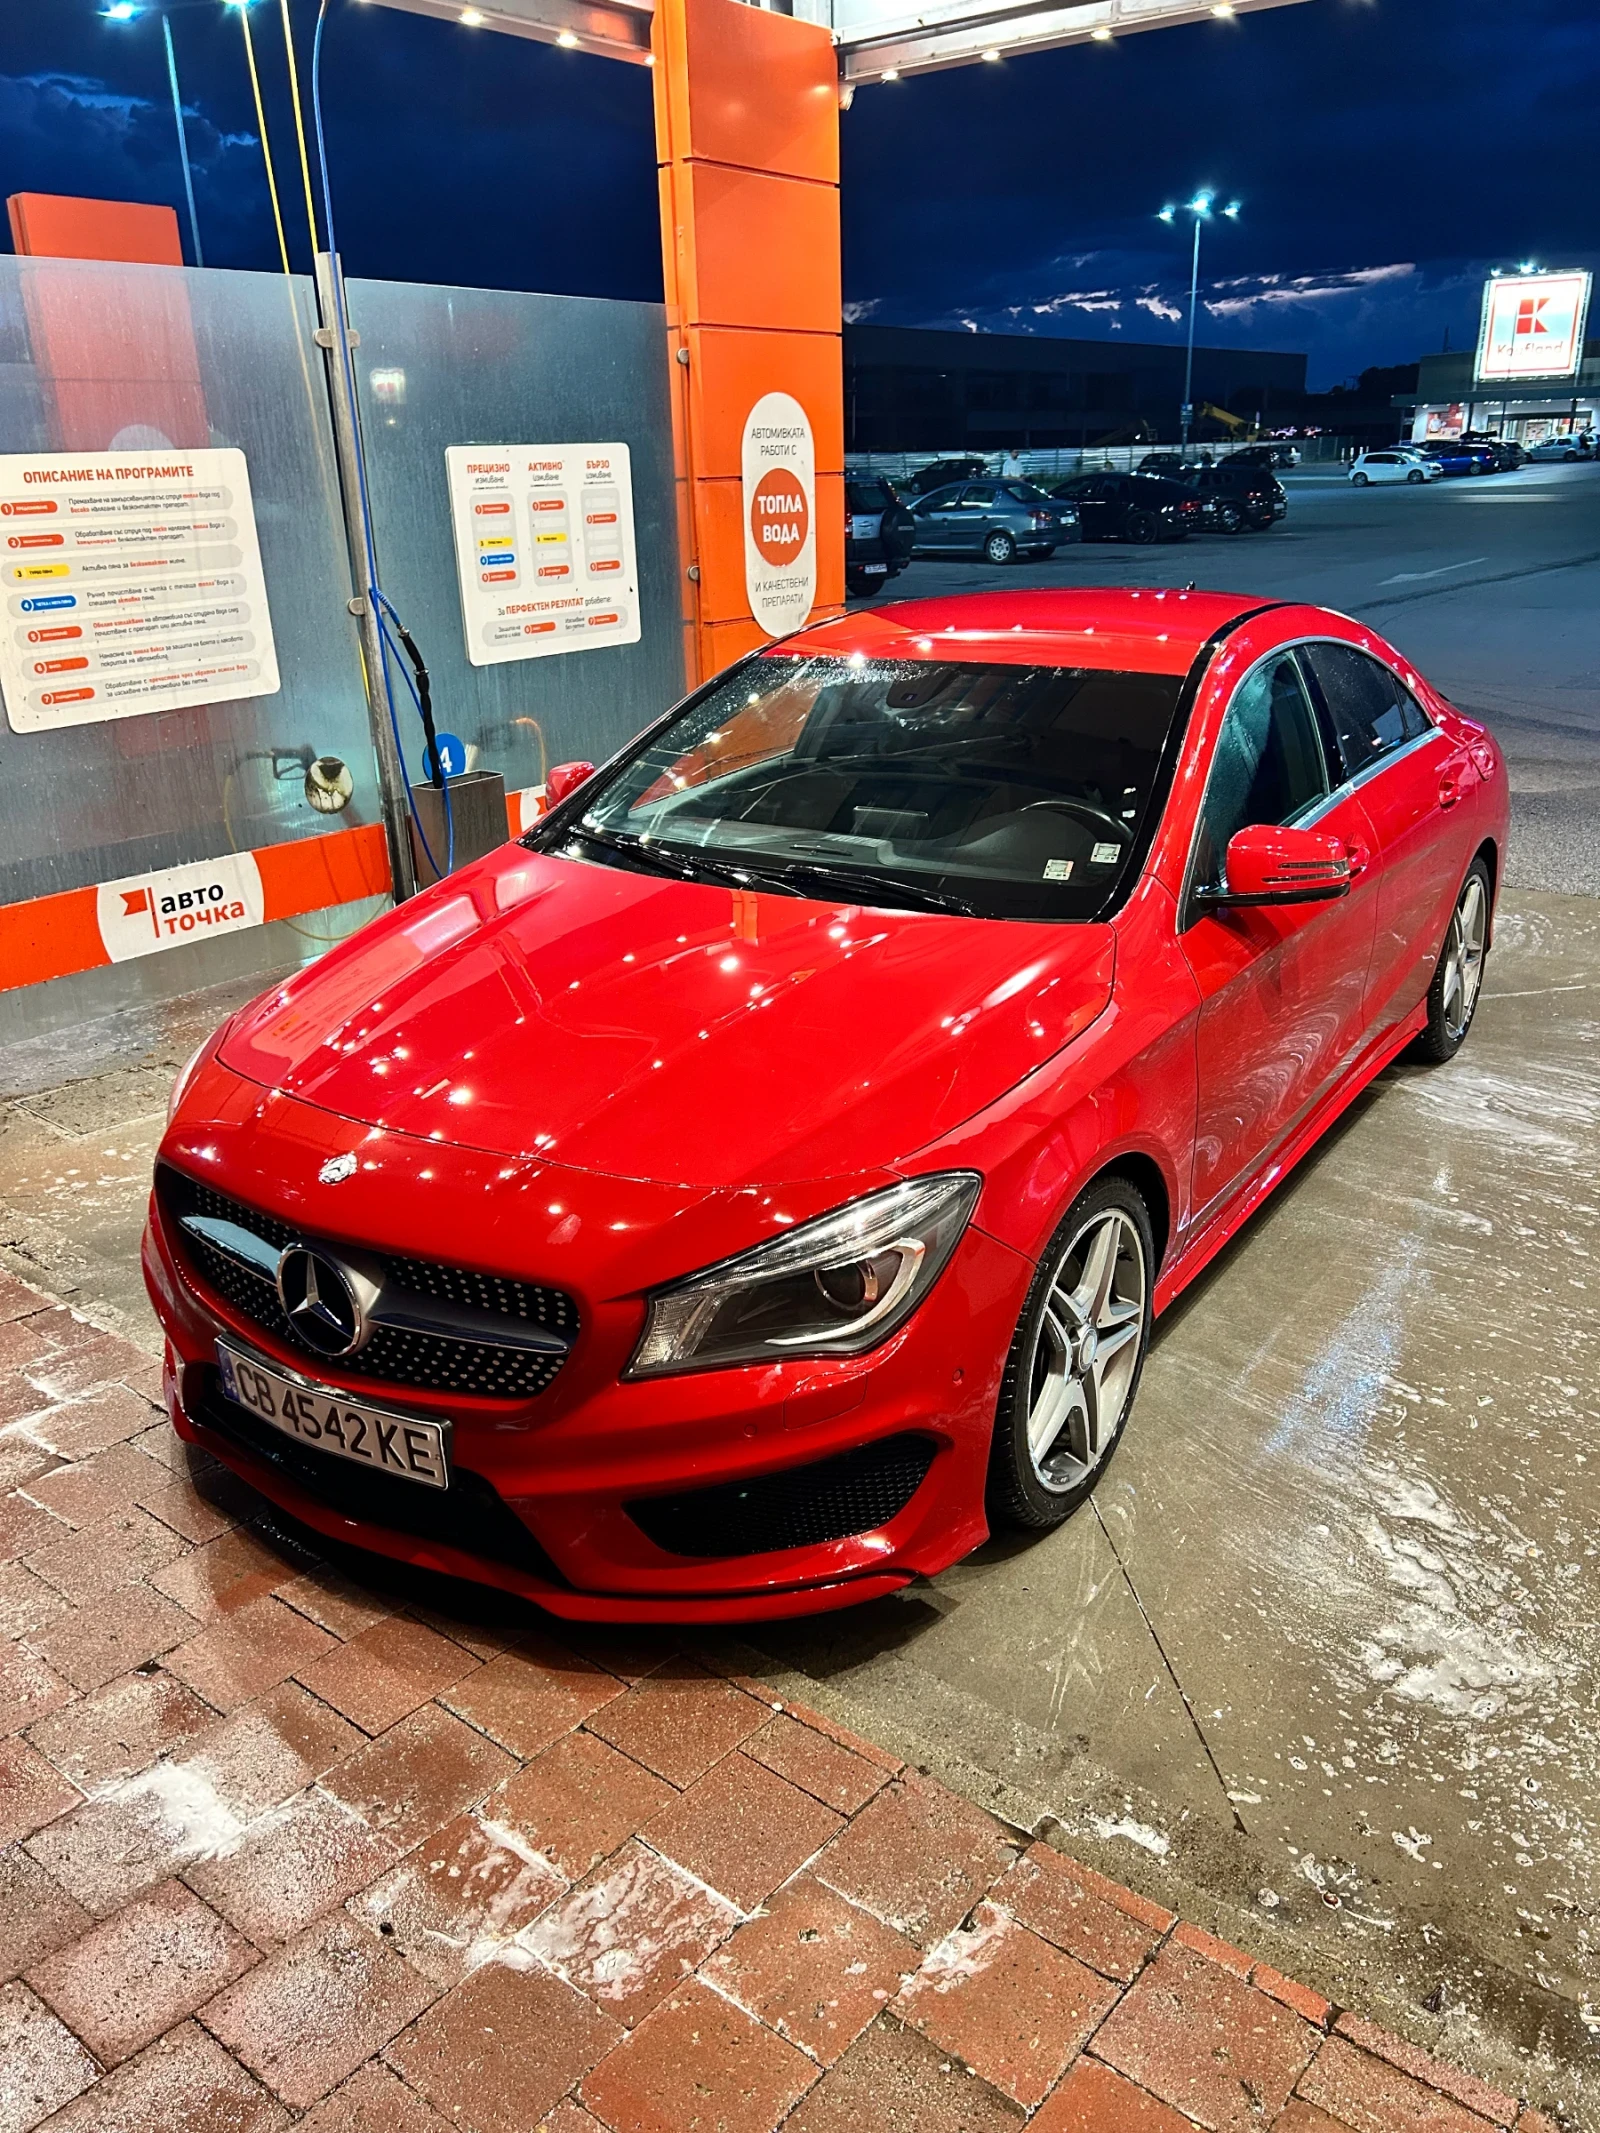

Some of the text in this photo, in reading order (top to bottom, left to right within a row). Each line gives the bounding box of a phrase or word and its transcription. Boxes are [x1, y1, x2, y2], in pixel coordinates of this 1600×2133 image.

[1498, 341, 1563, 357] Kafland
[751, 427, 806, 439] АВТОМИВКАТА
[760, 444, 797, 456] РАБОТИ С
[467, 464, 510, 473] ПРЕЦИЗНО
[528, 462, 562, 471] АКТИВНО
[586, 460, 610, 469] БЪРЗО
[23, 465, 194, 484] ОПИСАНИЕ НА ПРОГРАМИТЕ
[758, 494, 803, 514] ТОПЛА
[762, 523, 800, 544] ВОДА
[17, 570, 23, 578] 3
[755, 576, 809, 592] И КАЧЕСТВЕНИ
[24, 601, 30, 609] 4
[506, 602, 550, 614] ПЕРФЕКТЕН
[551, 598, 584, 609] РЕЗУЛТАТ
[762, 593, 803, 608] ПРЕПАРАТИ
[440, 746, 453, 773] 4
[160, 884, 224, 914] авто
[164, 901, 245, 935] точка
